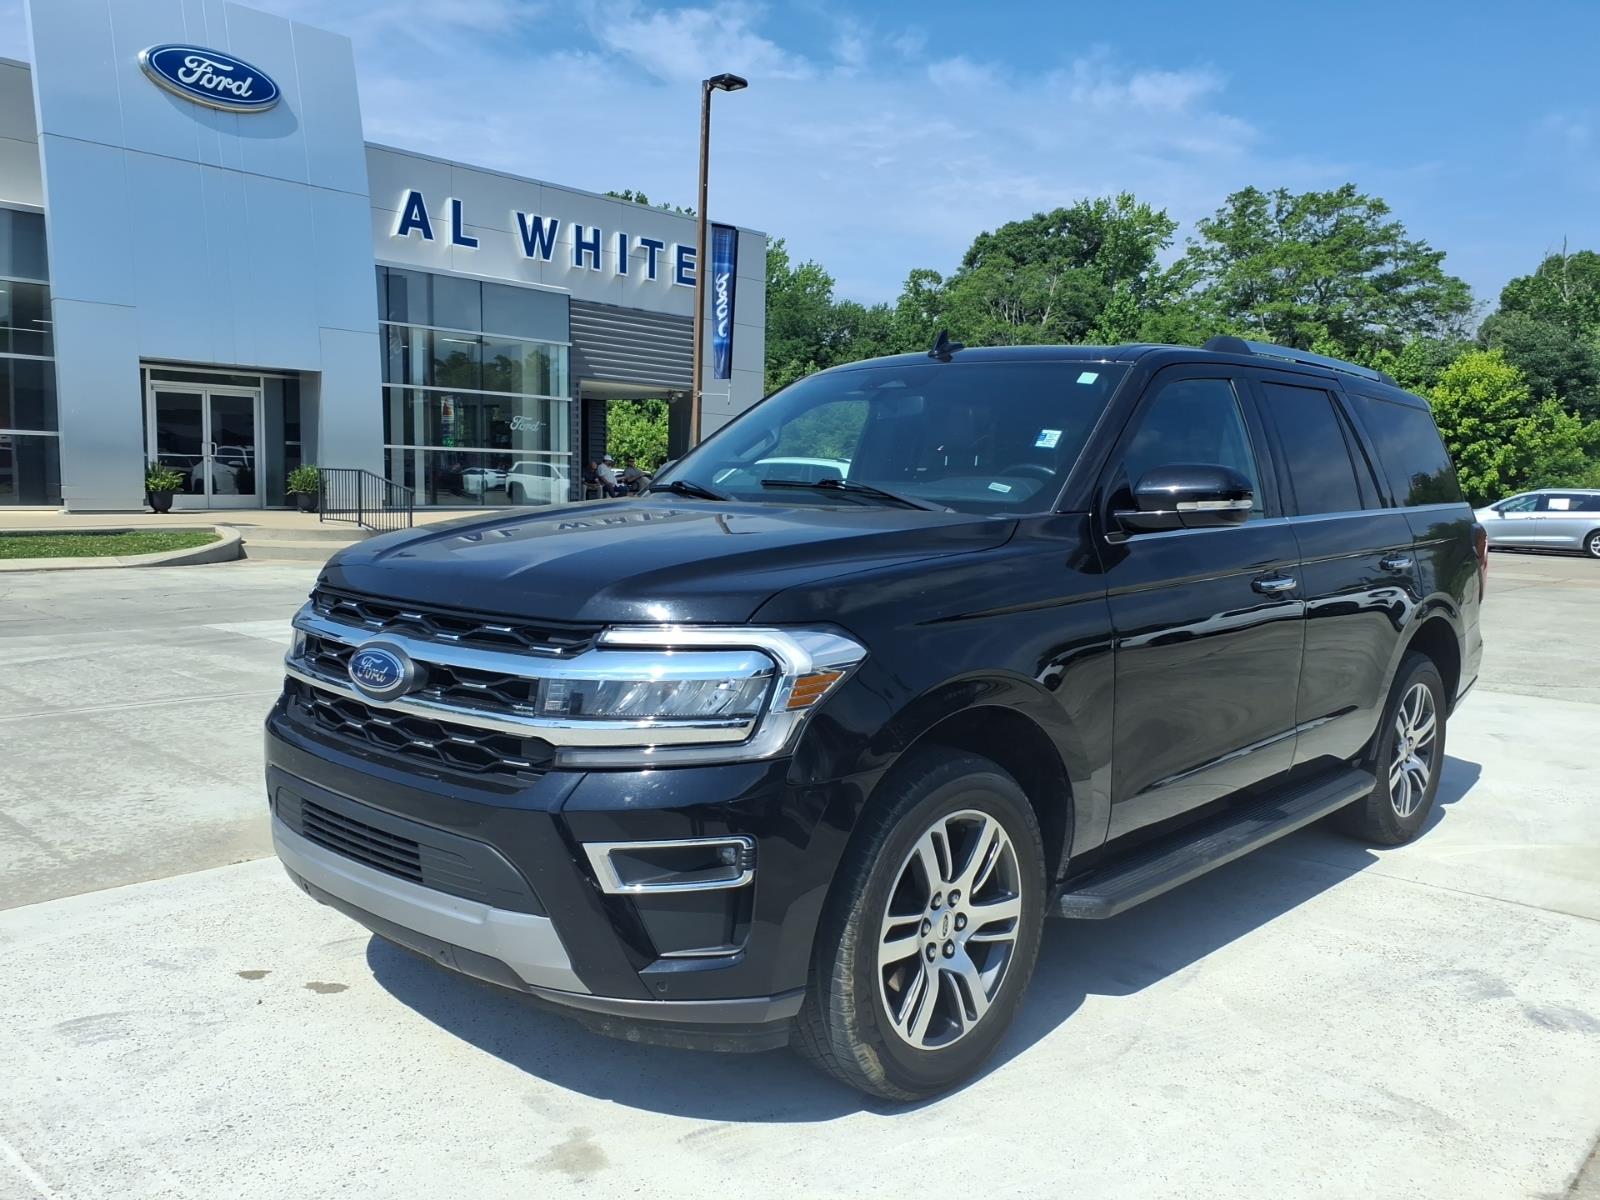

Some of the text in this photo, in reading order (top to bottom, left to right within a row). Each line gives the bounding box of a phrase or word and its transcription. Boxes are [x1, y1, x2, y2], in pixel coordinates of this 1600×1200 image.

[178, 55, 253, 97] Ford
[393, 189, 697, 288] AL WHITE
[510, 415, 541, 432] Ford
[357, 655, 390, 683] Ford
